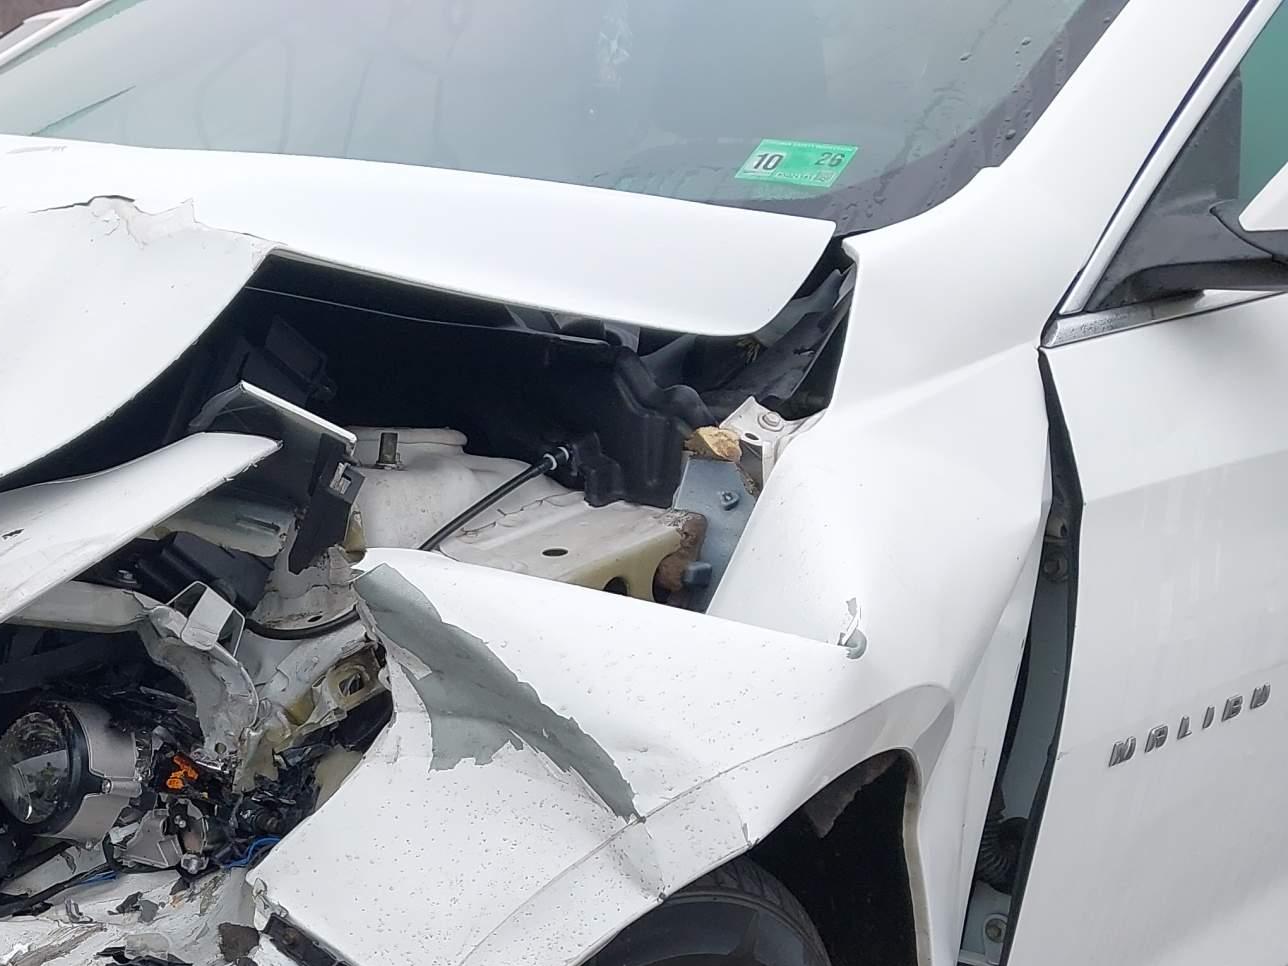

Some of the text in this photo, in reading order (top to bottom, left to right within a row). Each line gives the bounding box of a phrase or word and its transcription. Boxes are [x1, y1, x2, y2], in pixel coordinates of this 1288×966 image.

[753, 153, 784, 171] 10
[814, 152, 846, 168] 26
[1108, 682, 1272, 768] MALIBU
